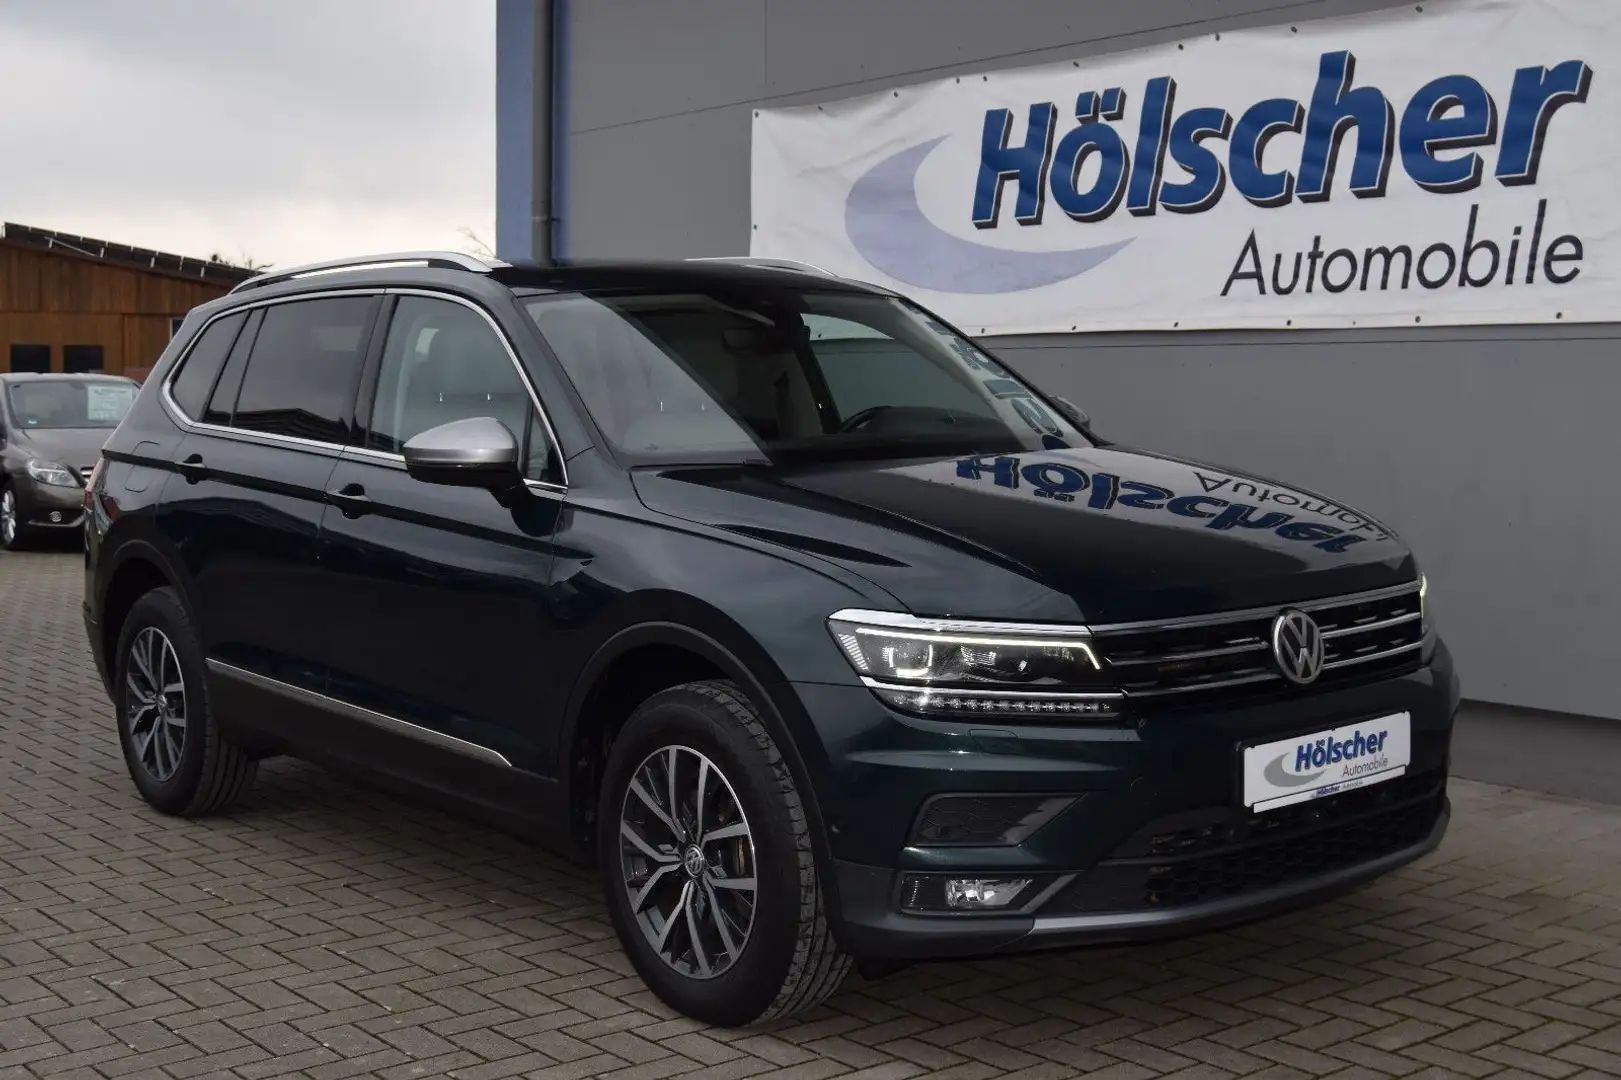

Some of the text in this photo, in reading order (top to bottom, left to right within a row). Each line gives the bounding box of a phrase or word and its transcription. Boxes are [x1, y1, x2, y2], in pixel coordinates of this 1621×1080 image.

[972, 50, 1594, 230] Hölscher
[1220, 199, 1584, 297] Automobile
[1294, 730, 1388, 773] Hölscher
[1342, 753, 1388, 778] Automobile
